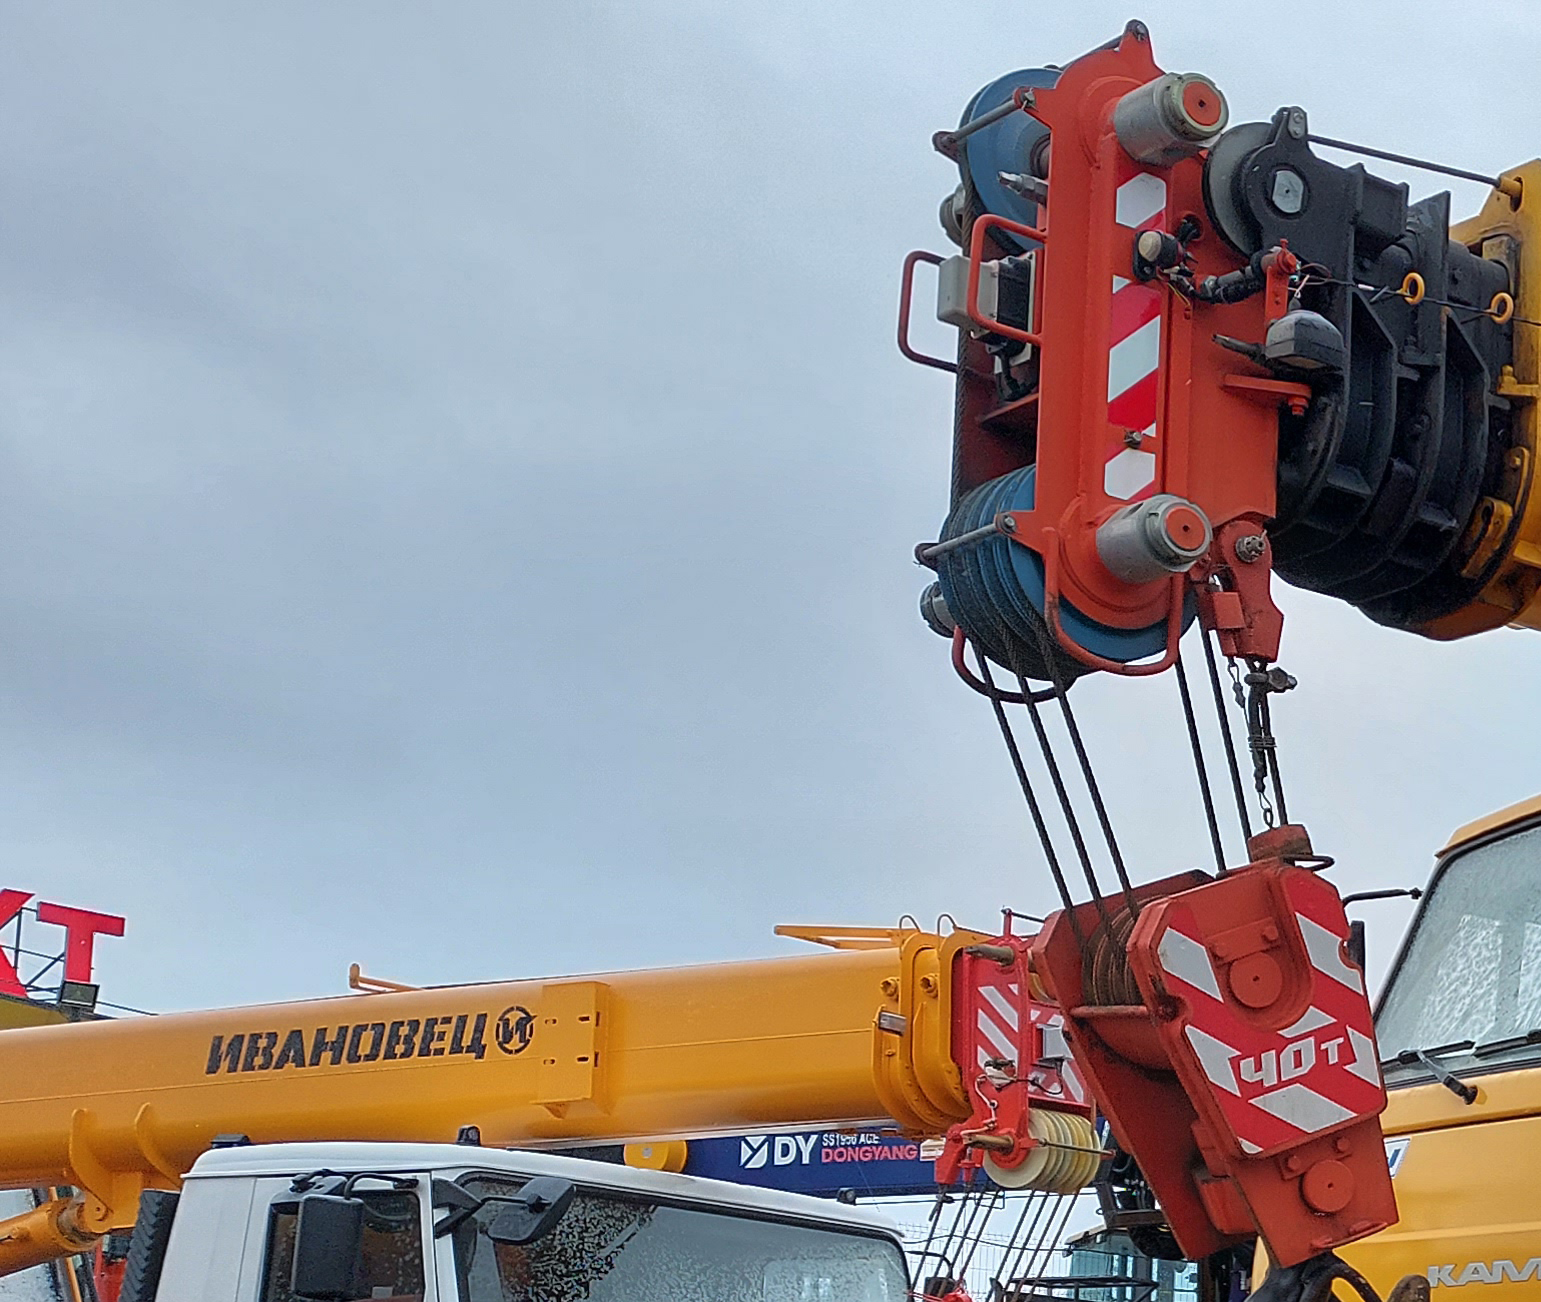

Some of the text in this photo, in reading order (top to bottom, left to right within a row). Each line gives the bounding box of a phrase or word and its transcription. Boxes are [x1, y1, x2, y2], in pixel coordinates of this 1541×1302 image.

[204, 1013, 488, 1075] ИВАНОВЕЦ
[774, 1134, 819, 1165] DY
[821, 1145, 918, 1163] DONGYANG
